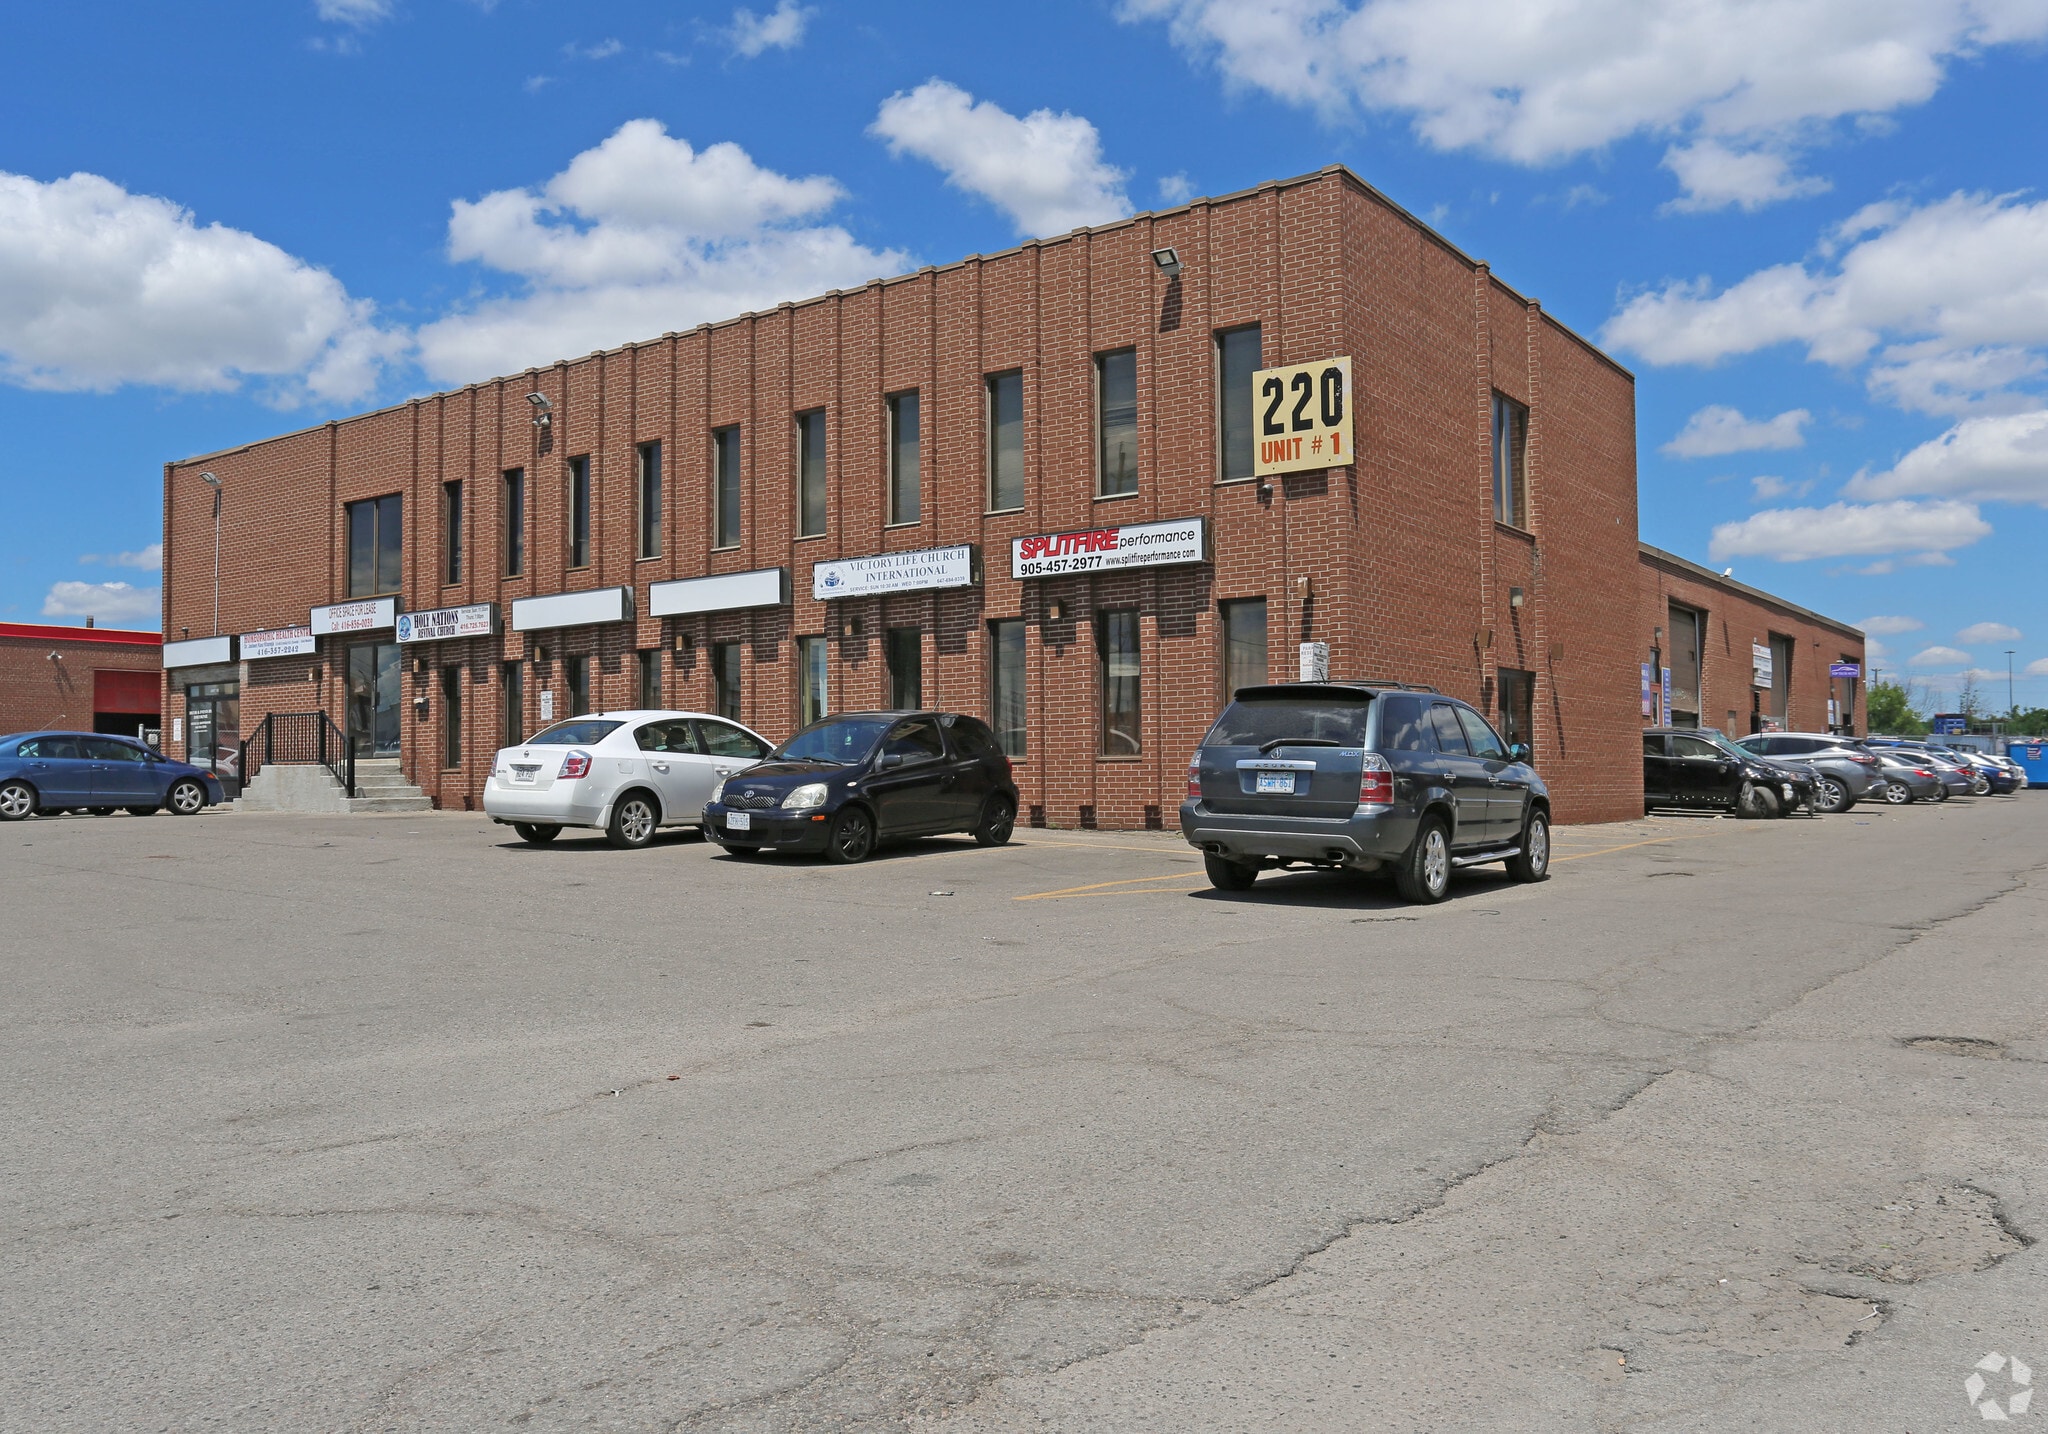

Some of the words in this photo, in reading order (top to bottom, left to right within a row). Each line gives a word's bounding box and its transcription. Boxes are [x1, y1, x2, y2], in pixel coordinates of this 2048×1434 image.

[1262, 366, 1343, 436] 220
[1261, 437, 1302, 464] UNIT
[1020, 528, 1119, 560] SPLITFIRE
[1120, 530, 1195, 551] performance
[850, 559, 892, 571] VICTORY
[896, 555, 918, 567] LIFE
[921, 549, 965, 563] CHURCH
[1021, 556, 1102, 575] 905-457-2977
[866, 565, 948, 582] INTERNATIONAL
[328, 606, 342, 619] OFFICE
[342, 605, 355, 617] SPACE
[355, 603, 364, 616] FOR
[364, 602, 376, 615] LEASE
[413, 613, 431, 629] HOLY
[431, 610, 459, 627] NATIONS
[244, 632, 275, 644] HOMEOPATHIC
[276, 630, 294, 640] HEALTH
[417, 626, 436, 639] REVIVAL
[437, 625, 456, 637] CHURCH
